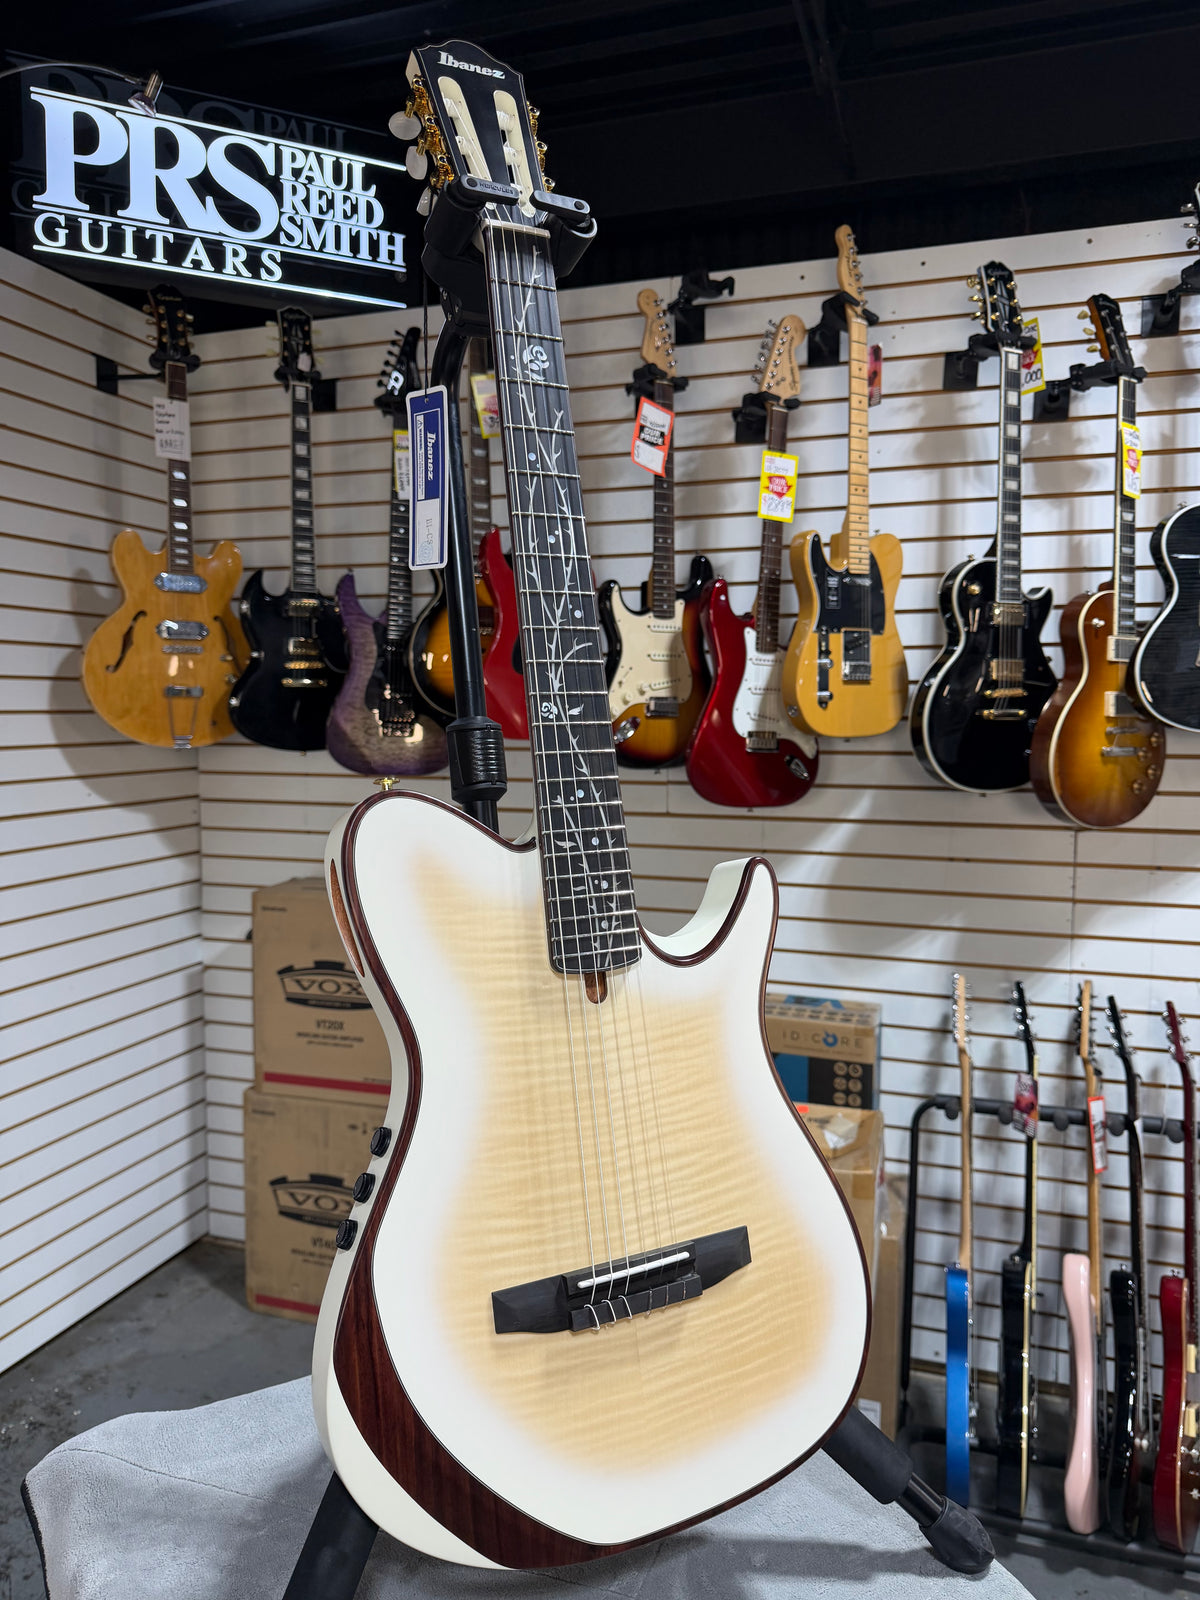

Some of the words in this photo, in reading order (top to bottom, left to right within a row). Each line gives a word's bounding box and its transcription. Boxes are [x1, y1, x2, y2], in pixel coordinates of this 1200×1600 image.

[437, 50, 505, 80] Ibanez
[30, 93, 280, 240] PRS
[278, 144, 377, 197] PAUL
[279, 178, 385, 230] REED
[33, 212, 283, 282] GUITARS
[279, 213, 407, 267] SMITH
[427, 431, 436, 481] Ibanez
[291, 978, 364, 996] VOX
